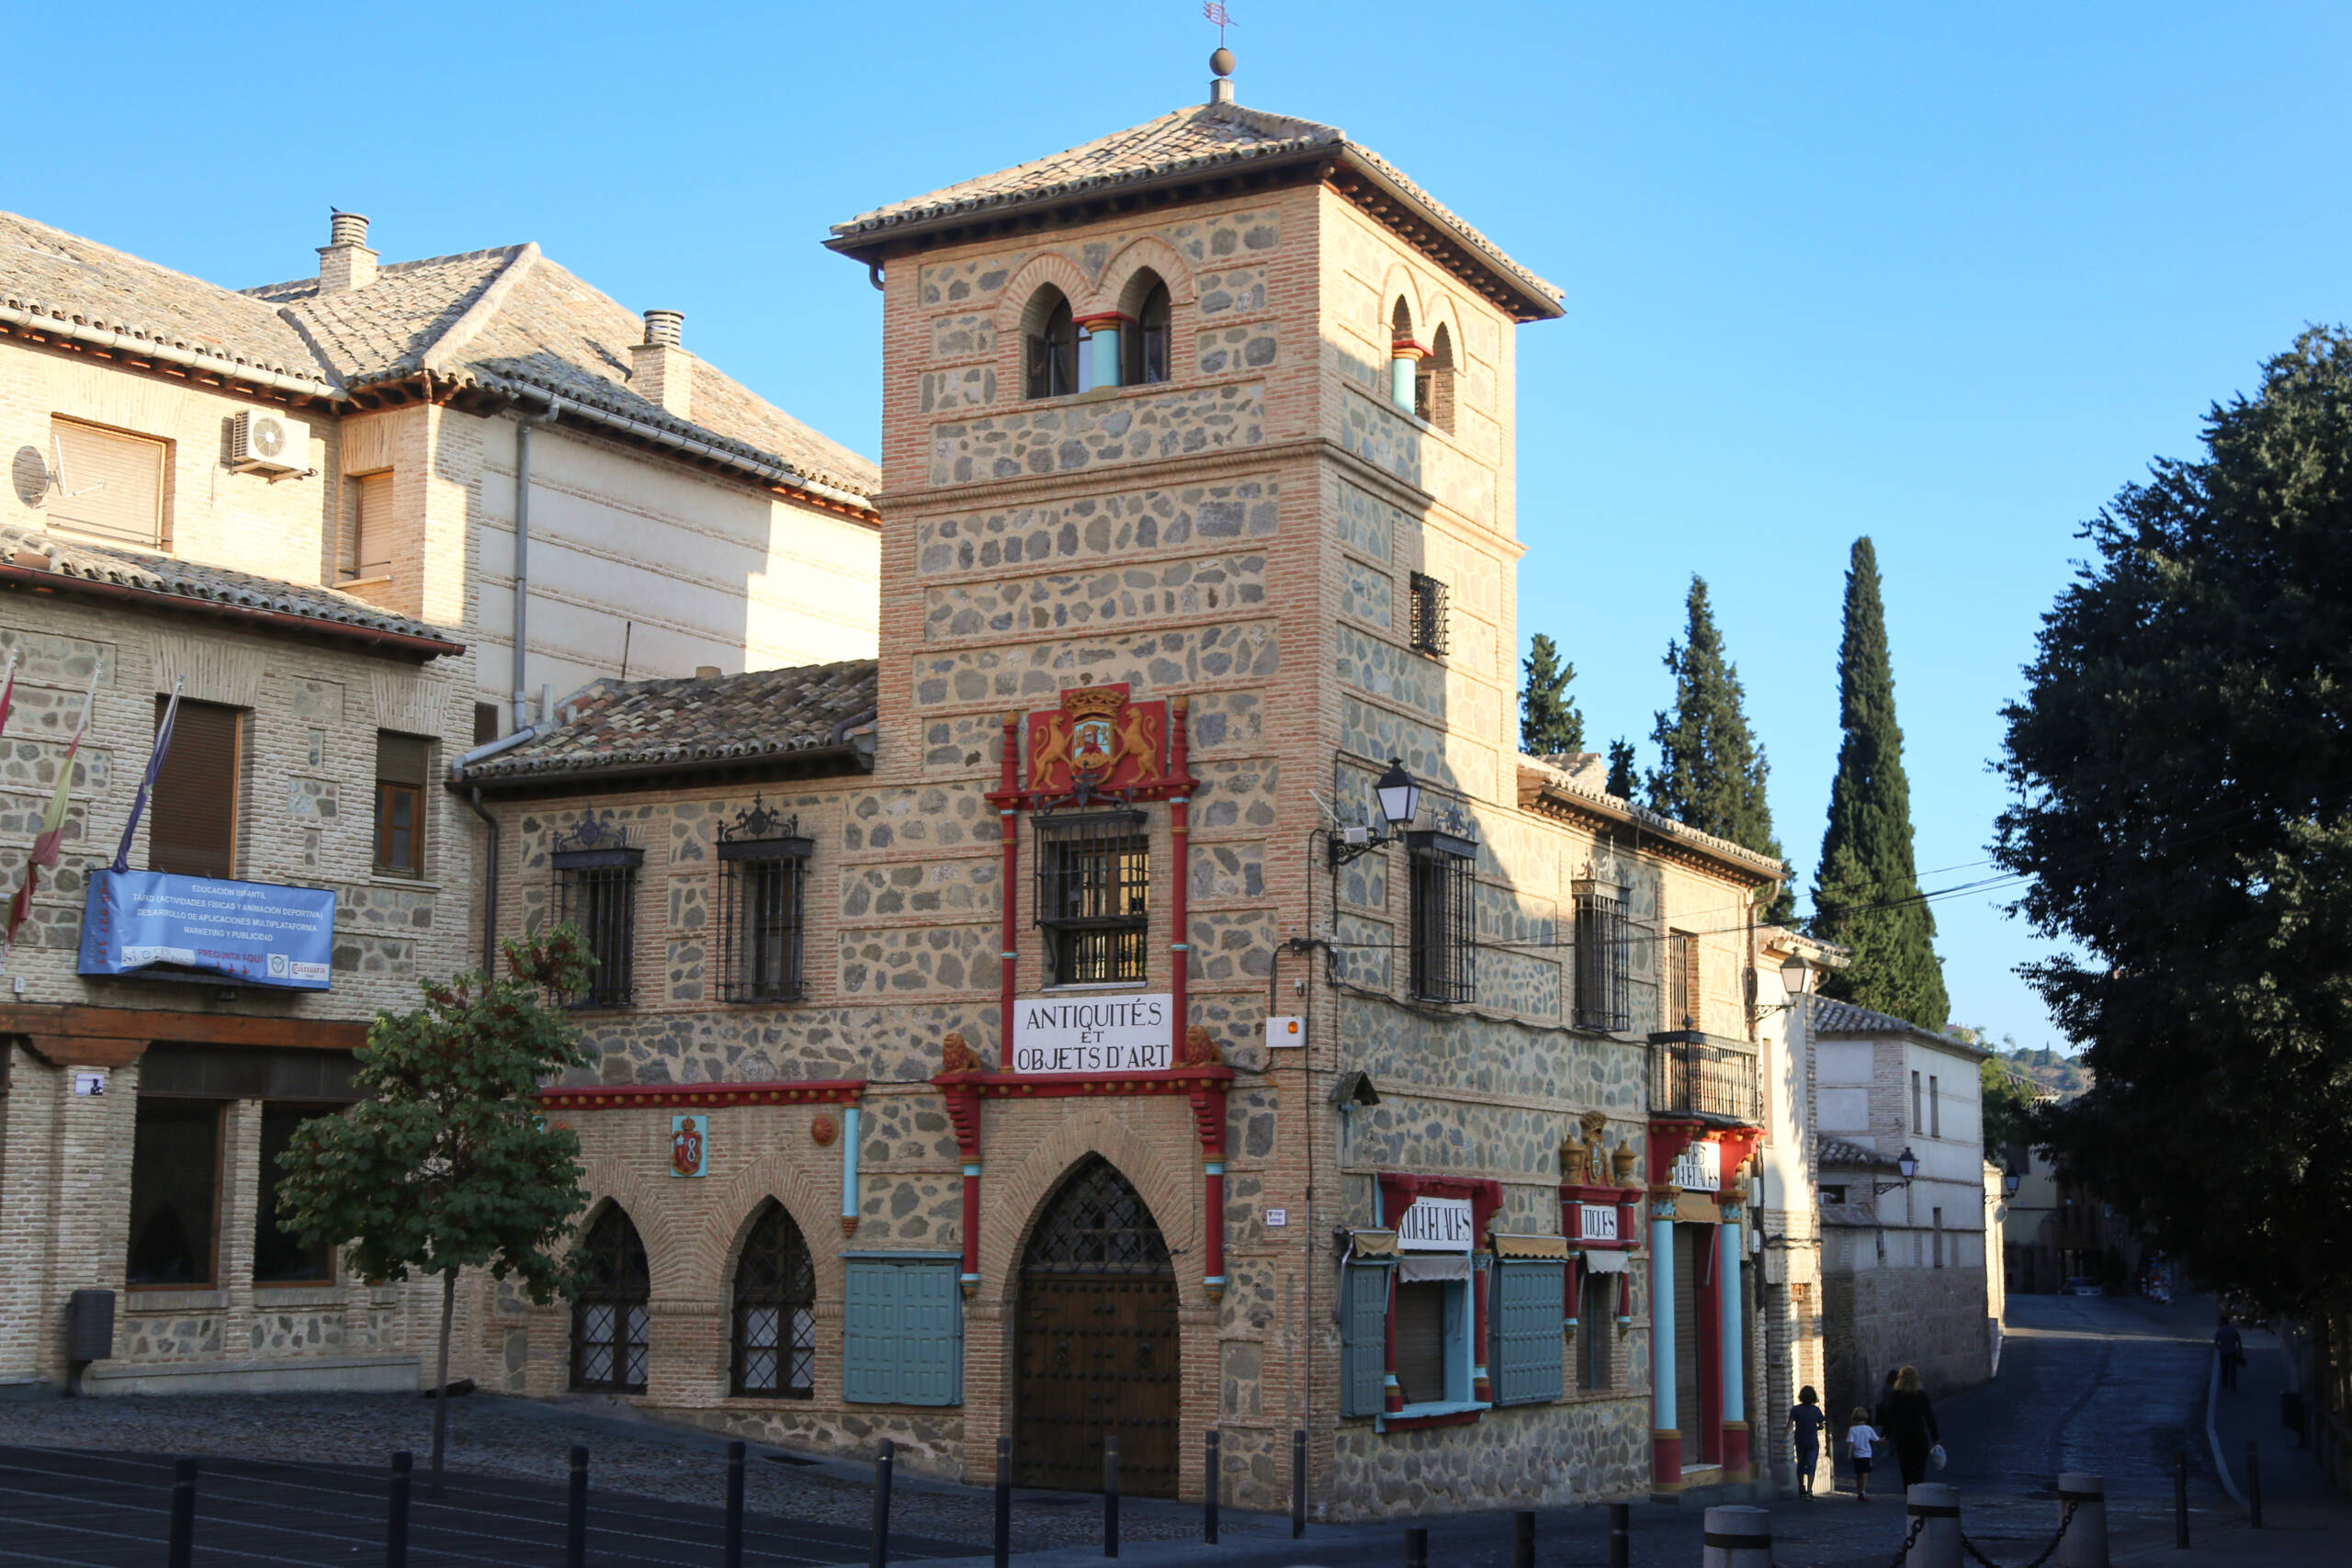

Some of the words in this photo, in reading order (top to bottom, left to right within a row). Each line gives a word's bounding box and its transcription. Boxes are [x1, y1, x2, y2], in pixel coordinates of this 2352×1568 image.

[191, 884, 234, 897] EDUCACIÓN
[235, 889, 267, 900] INFANTIL
[208, 899, 236, 910] FÍSICAS
[242, 904, 282, 915] ANIMACIÓN
[282, 908, 323, 919] DEPORTIVA)
[137, 908, 187, 919] DESARROLLO
[187, 912, 198, 920] DE
[198, 913, 251, 926] APLICACIONES
[252, 919, 318, 931] MULTIPLATAFORMA
[184, 926, 225, 937] MARKETING
[232, 931, 274, 942] PUBLICIDAD
[198, 948, 241, 961] PREGUNTA
[1026, 998, 1162, 1031] ANTIQUITÉS
[1080, 1031, 1104, 1043] ET
[1017, 1046, 1101, 1071] OBJETS
[1106, 1043, 1170, 1069] D'ART
[1582, 1208, 1615, 1238] TIQUES
